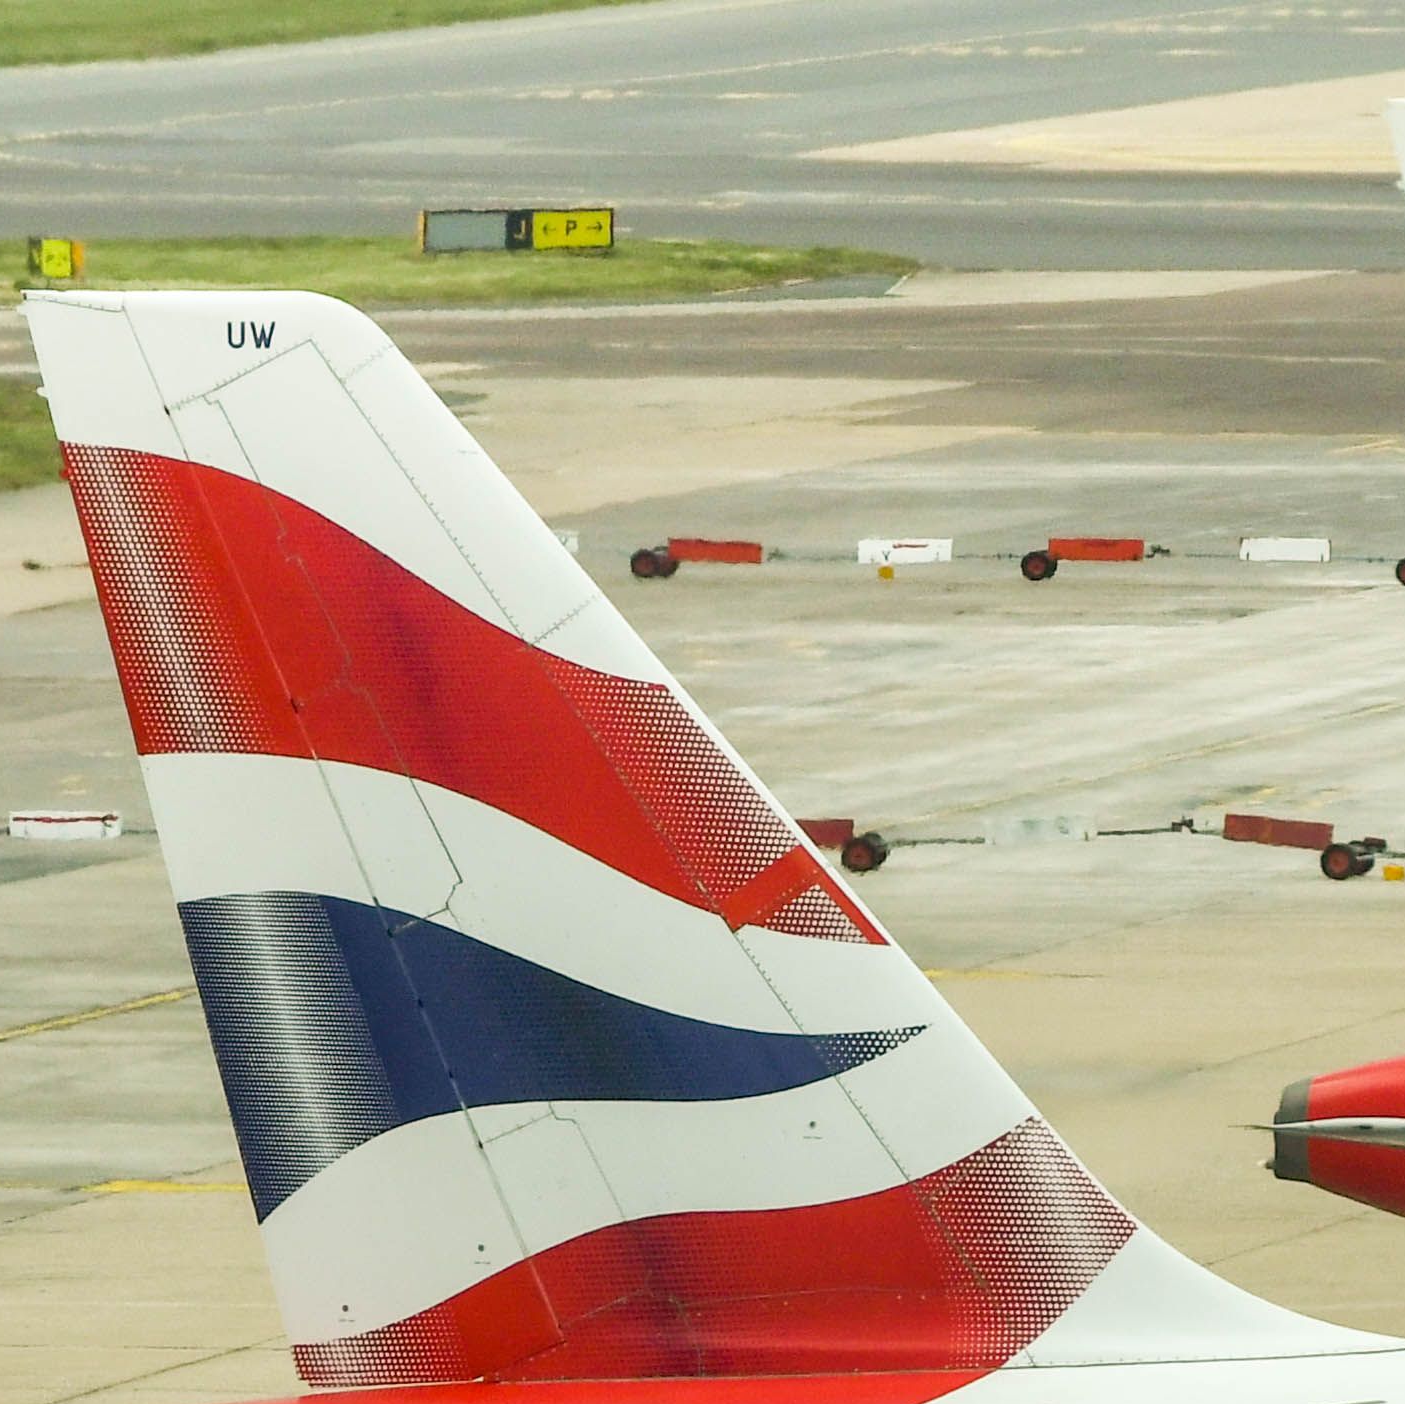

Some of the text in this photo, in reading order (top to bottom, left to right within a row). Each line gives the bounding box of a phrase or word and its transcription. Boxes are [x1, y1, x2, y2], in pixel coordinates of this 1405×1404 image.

[513, 219, 578, 240] J P
[227, 321, 276, 349] UW
